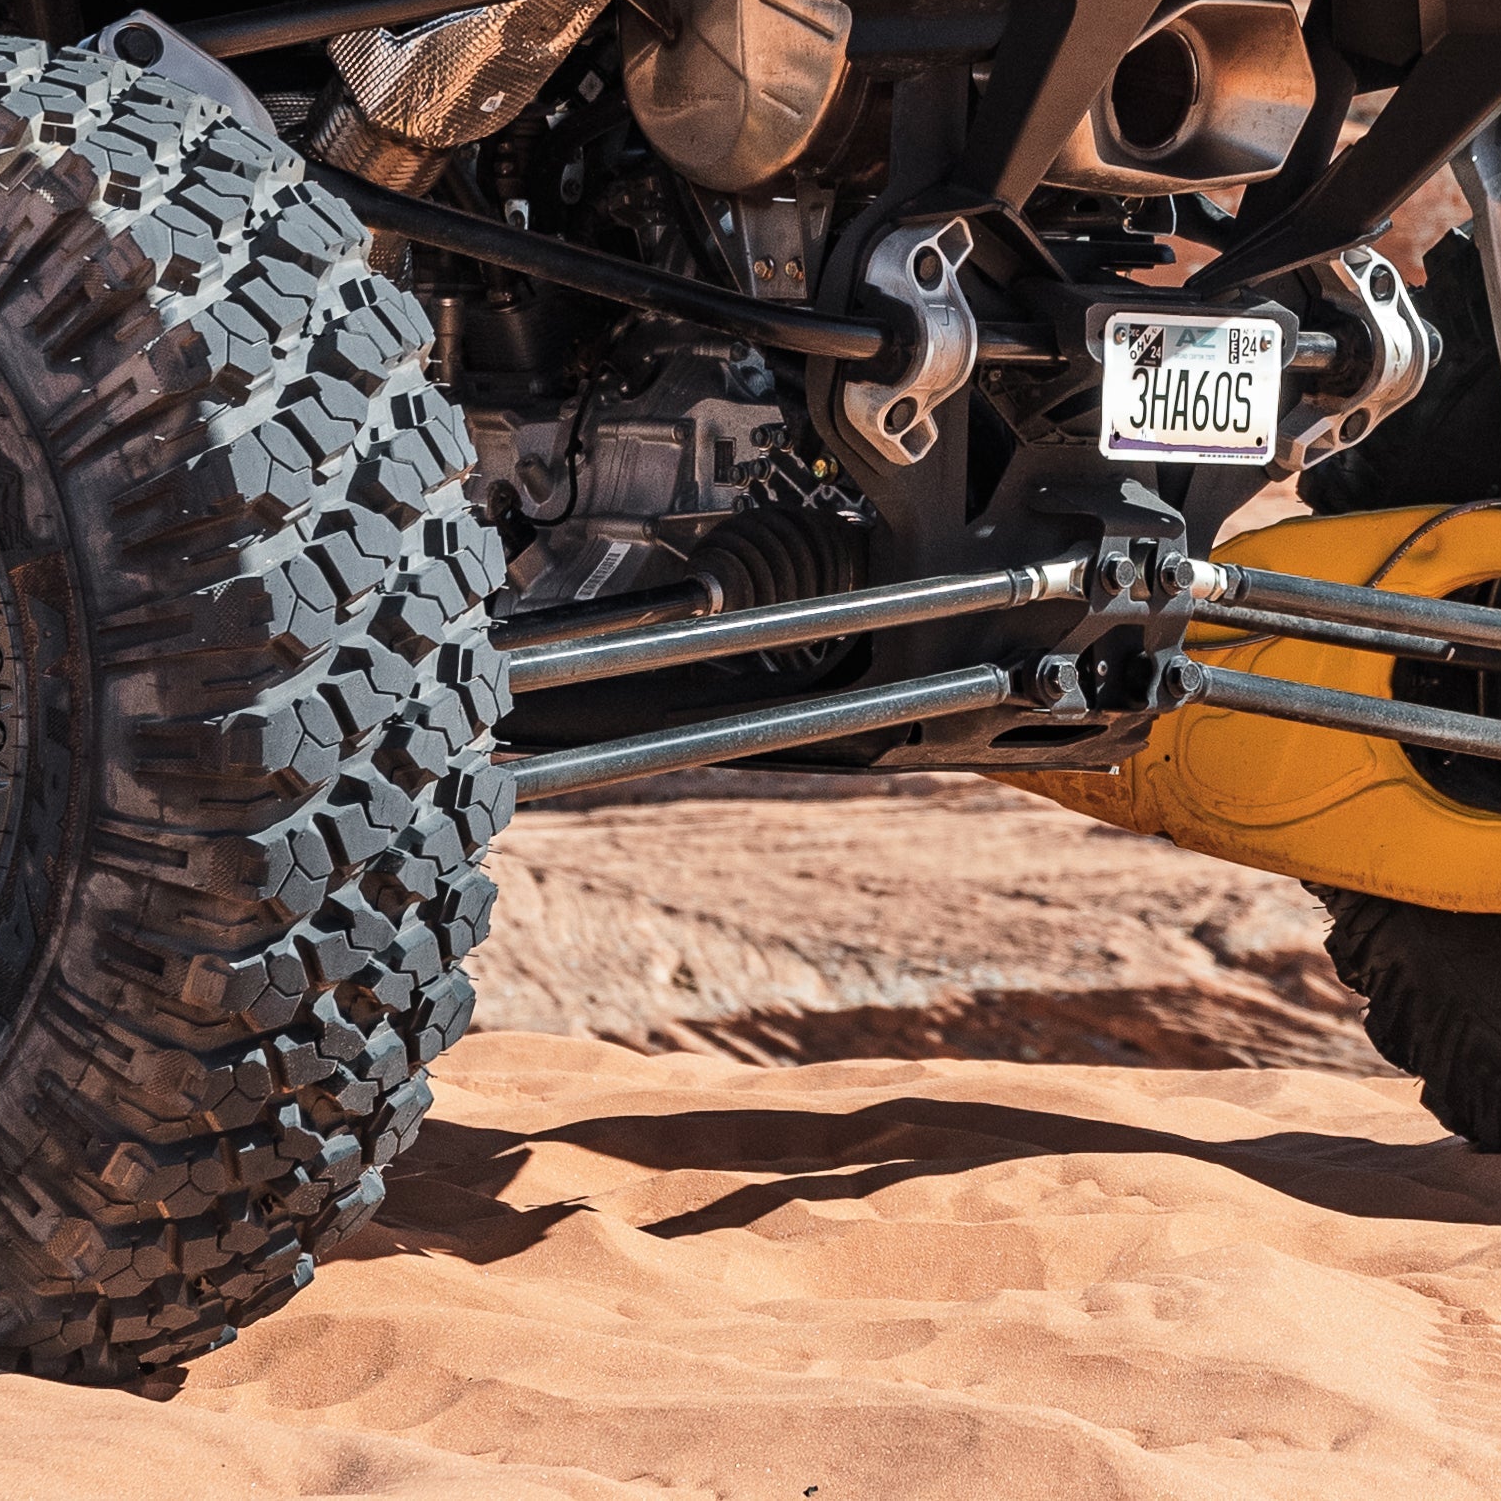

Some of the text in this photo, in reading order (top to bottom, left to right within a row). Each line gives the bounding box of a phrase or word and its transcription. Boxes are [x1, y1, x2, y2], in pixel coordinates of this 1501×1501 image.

[1129, 333, 1152, 360] OHV
[1175, 327, 1217, 349] AZ
[1228, 328, 1240, 364] DEC
[1241, 335, 1257, 358] 24
[1150, 345, 1161, 359] 24
[1129, 366, 1253, 434] 3HA60S
